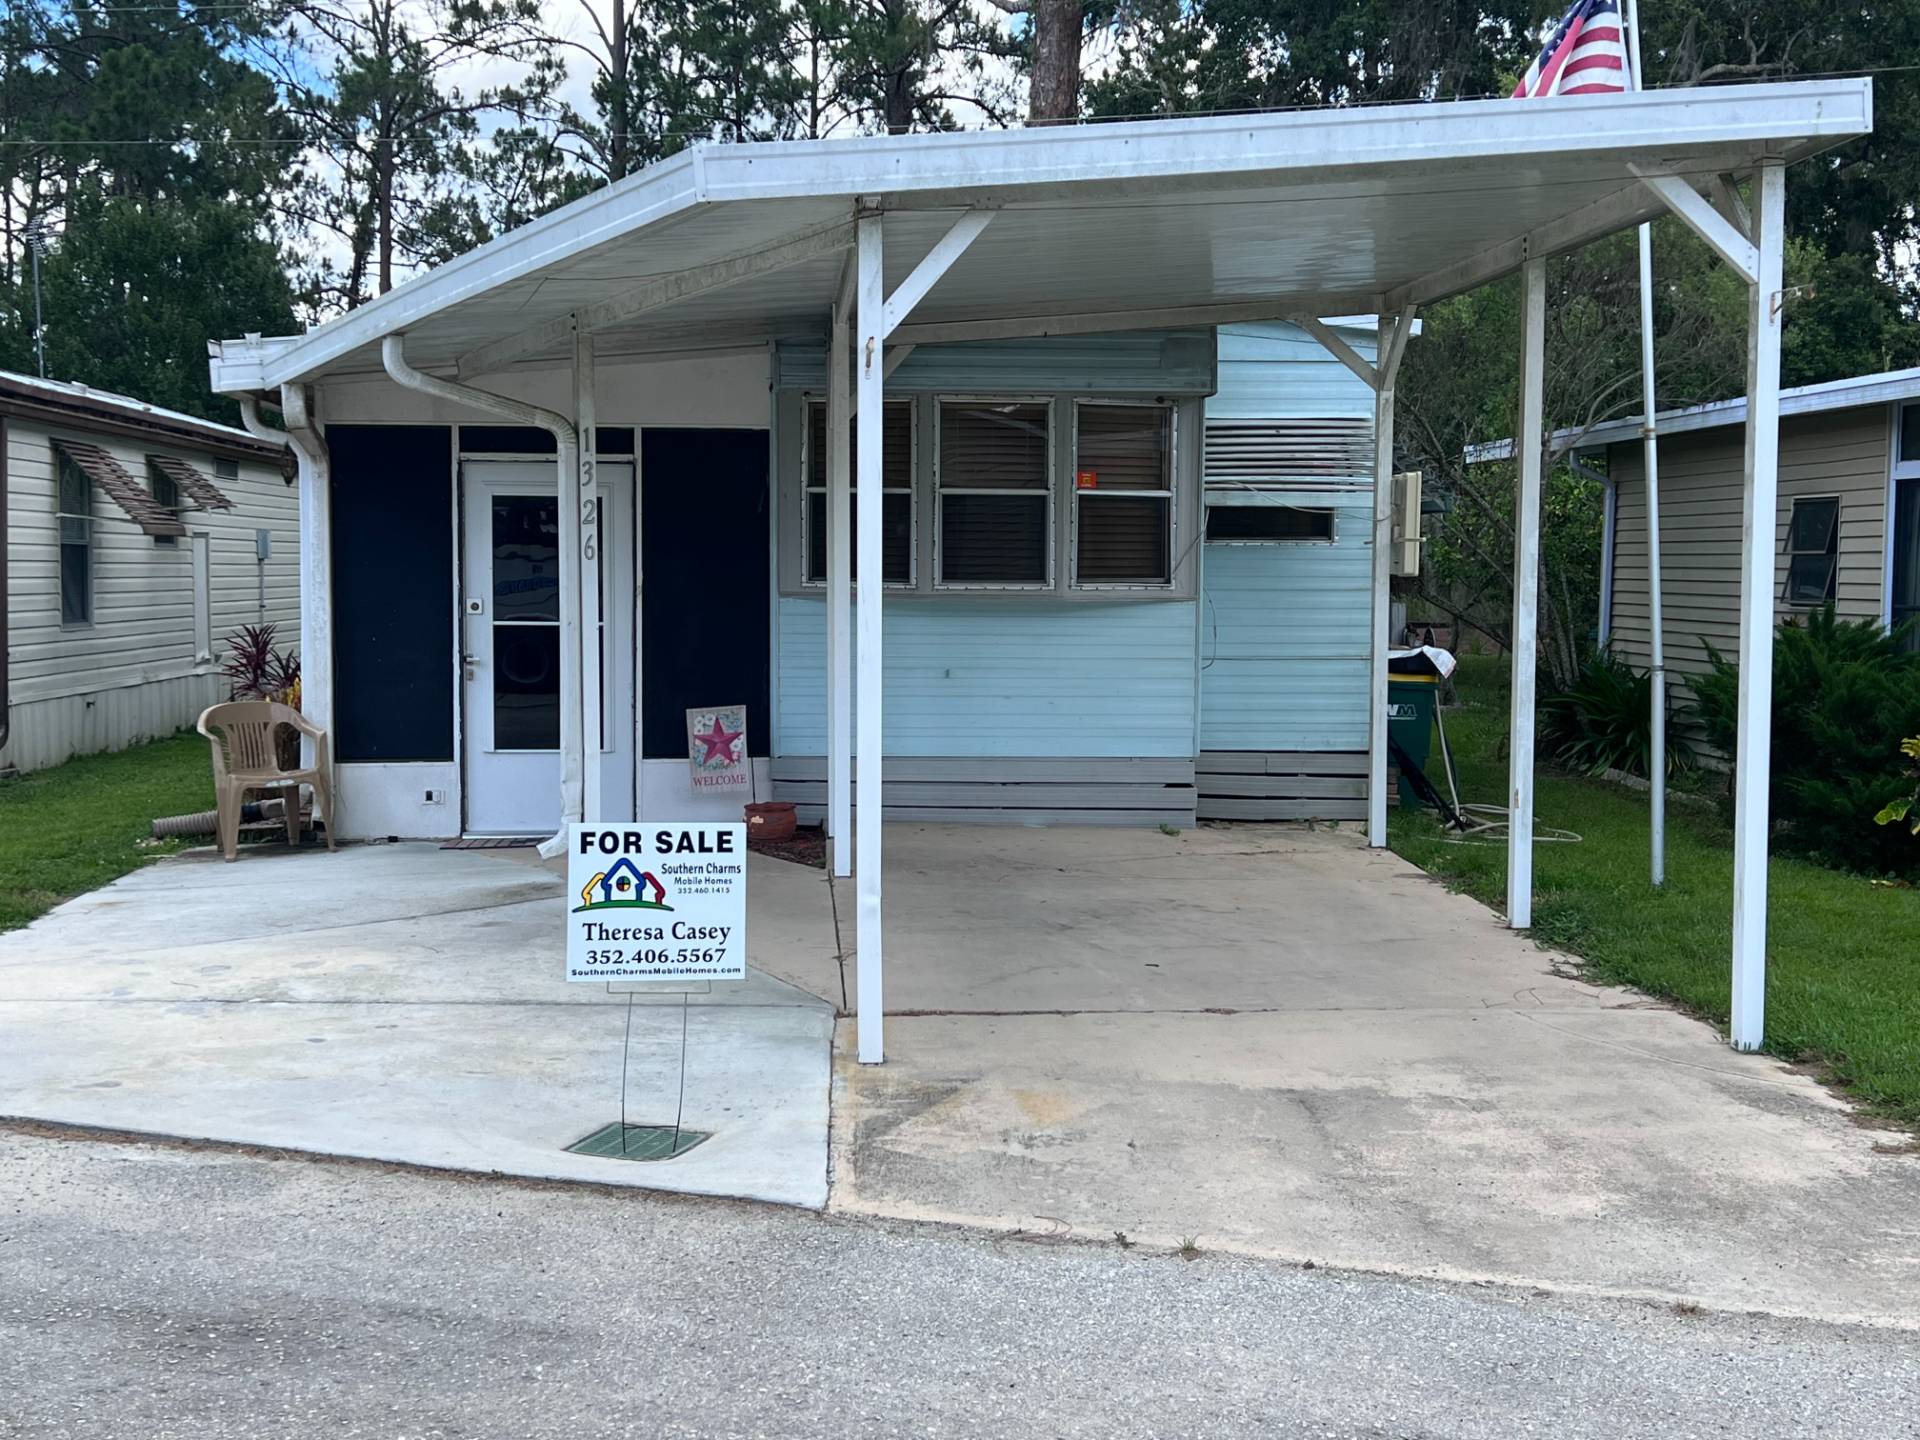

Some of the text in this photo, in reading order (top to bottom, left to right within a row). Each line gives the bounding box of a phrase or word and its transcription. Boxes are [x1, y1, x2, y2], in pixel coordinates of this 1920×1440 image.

[581, 427, 596, 560] 1326
[693, 774, 747, 787] WELCOME
[580, 830, 734, 854] FOR SALE
[661, 862, 741, 874] Southern Charms
[674, 876, 733, 885] Mobile Homes
[582, 921, 731, 945] Theresa Casey
[586, 948, 727, 964] 352.406.5567
[571, 966, 741, 976] SouthernCharmsMobileHomes.com
